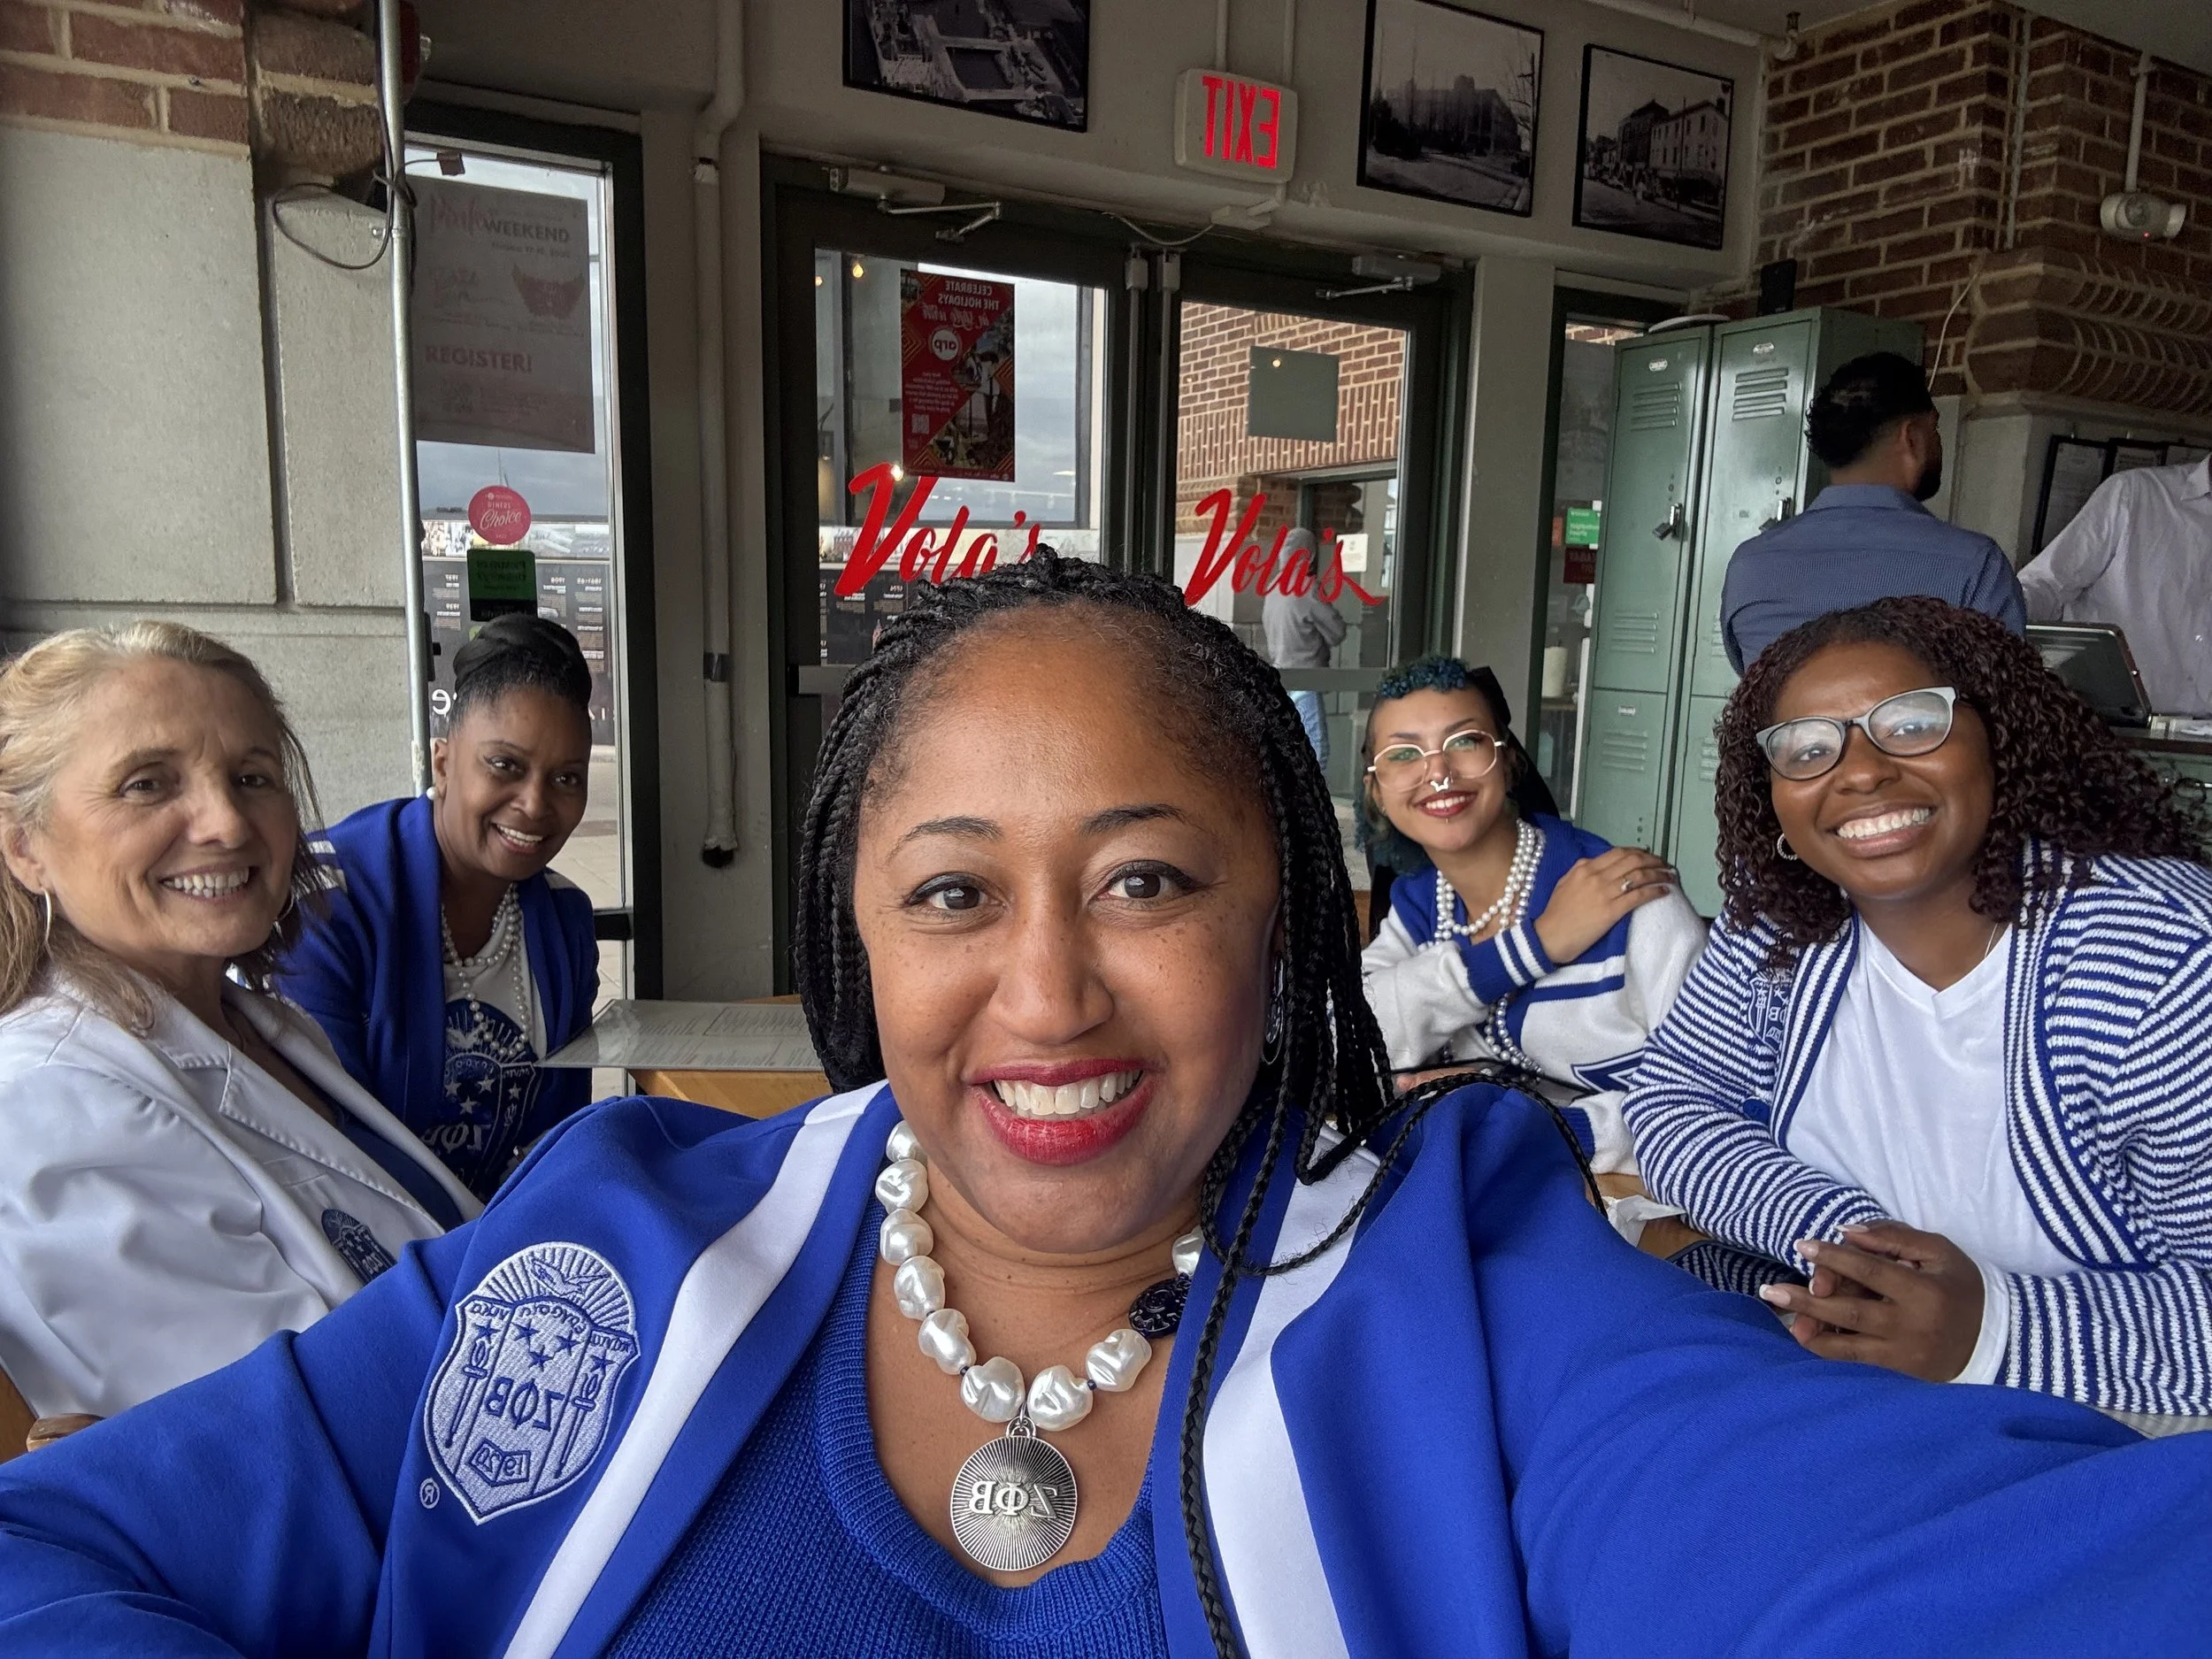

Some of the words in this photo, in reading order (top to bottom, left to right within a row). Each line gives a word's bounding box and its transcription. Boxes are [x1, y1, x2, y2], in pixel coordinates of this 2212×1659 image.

[484, 219, 570, 243] WEEKEND
[426, 344, 533, 373] REGISTER!
[480, 508, 522, 530] Choice
[1184, 488, 1387, 607] Vola's
